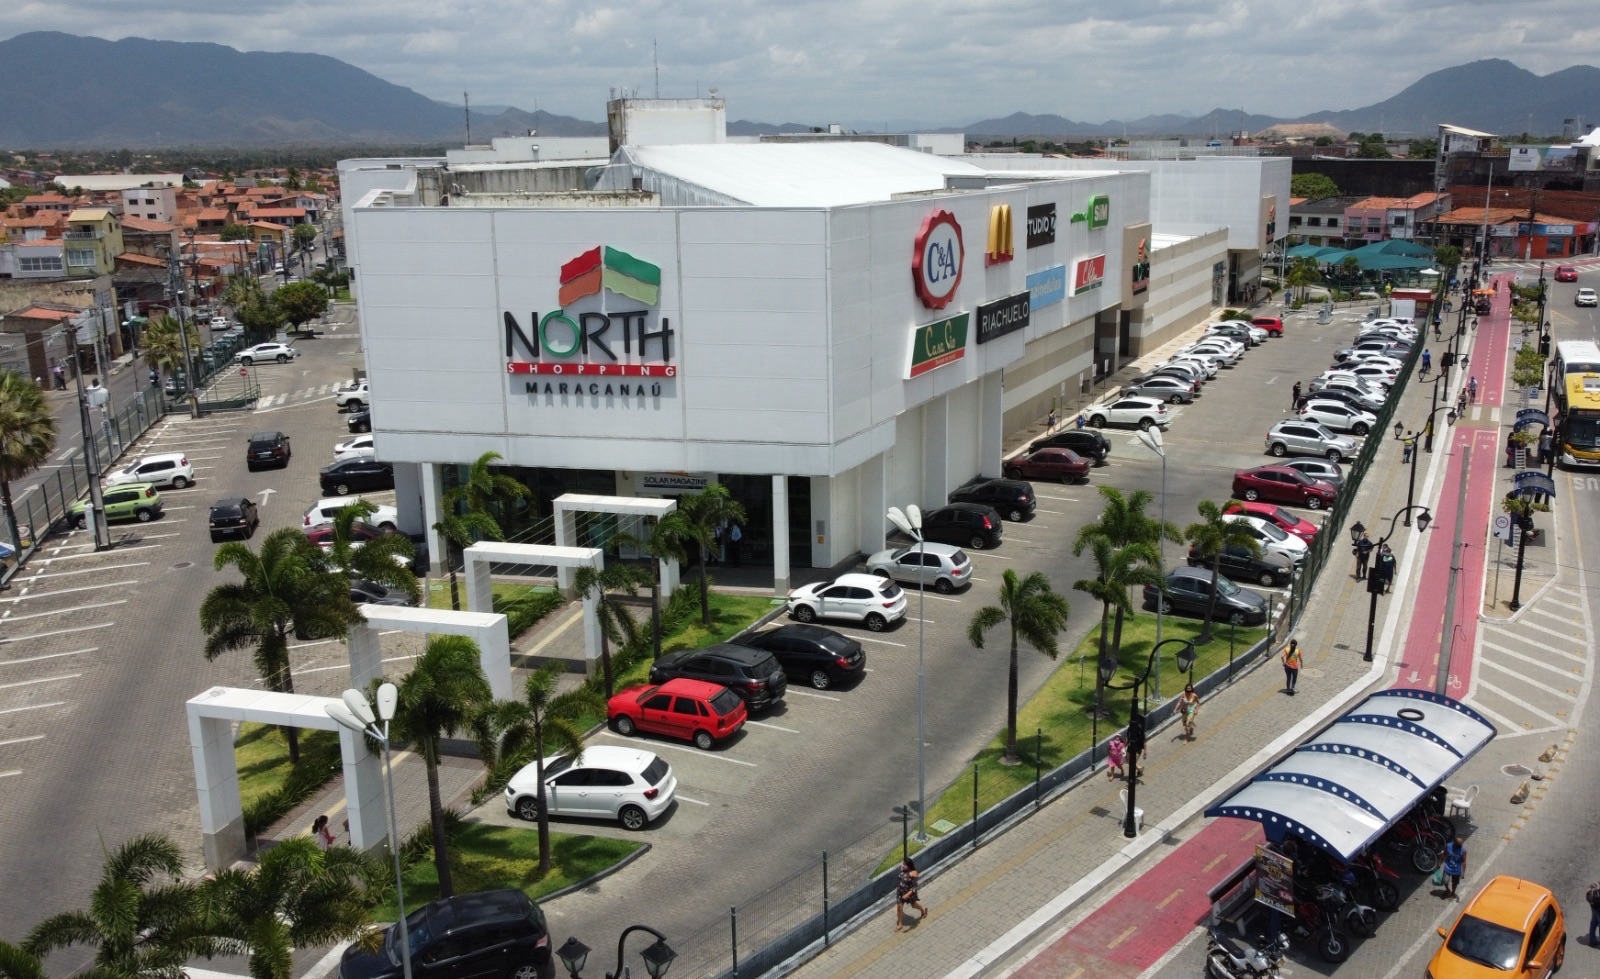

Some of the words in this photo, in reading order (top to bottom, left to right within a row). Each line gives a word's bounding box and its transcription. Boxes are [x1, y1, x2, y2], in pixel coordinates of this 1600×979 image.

[928, 238, 956, 283] C&A
[982, 301, 1029, 334] RIACHUELO
[504, 309, 674, 362] NORTH
[926, 326, 945, 357] Casa
[507, 364, 675, 376] SHOPPING
[526, 381, 661, 397] MARACANAÚ
[643, 476, 669, 485] SOLAR
[669, 477, 708, 486] MAGAZINE
